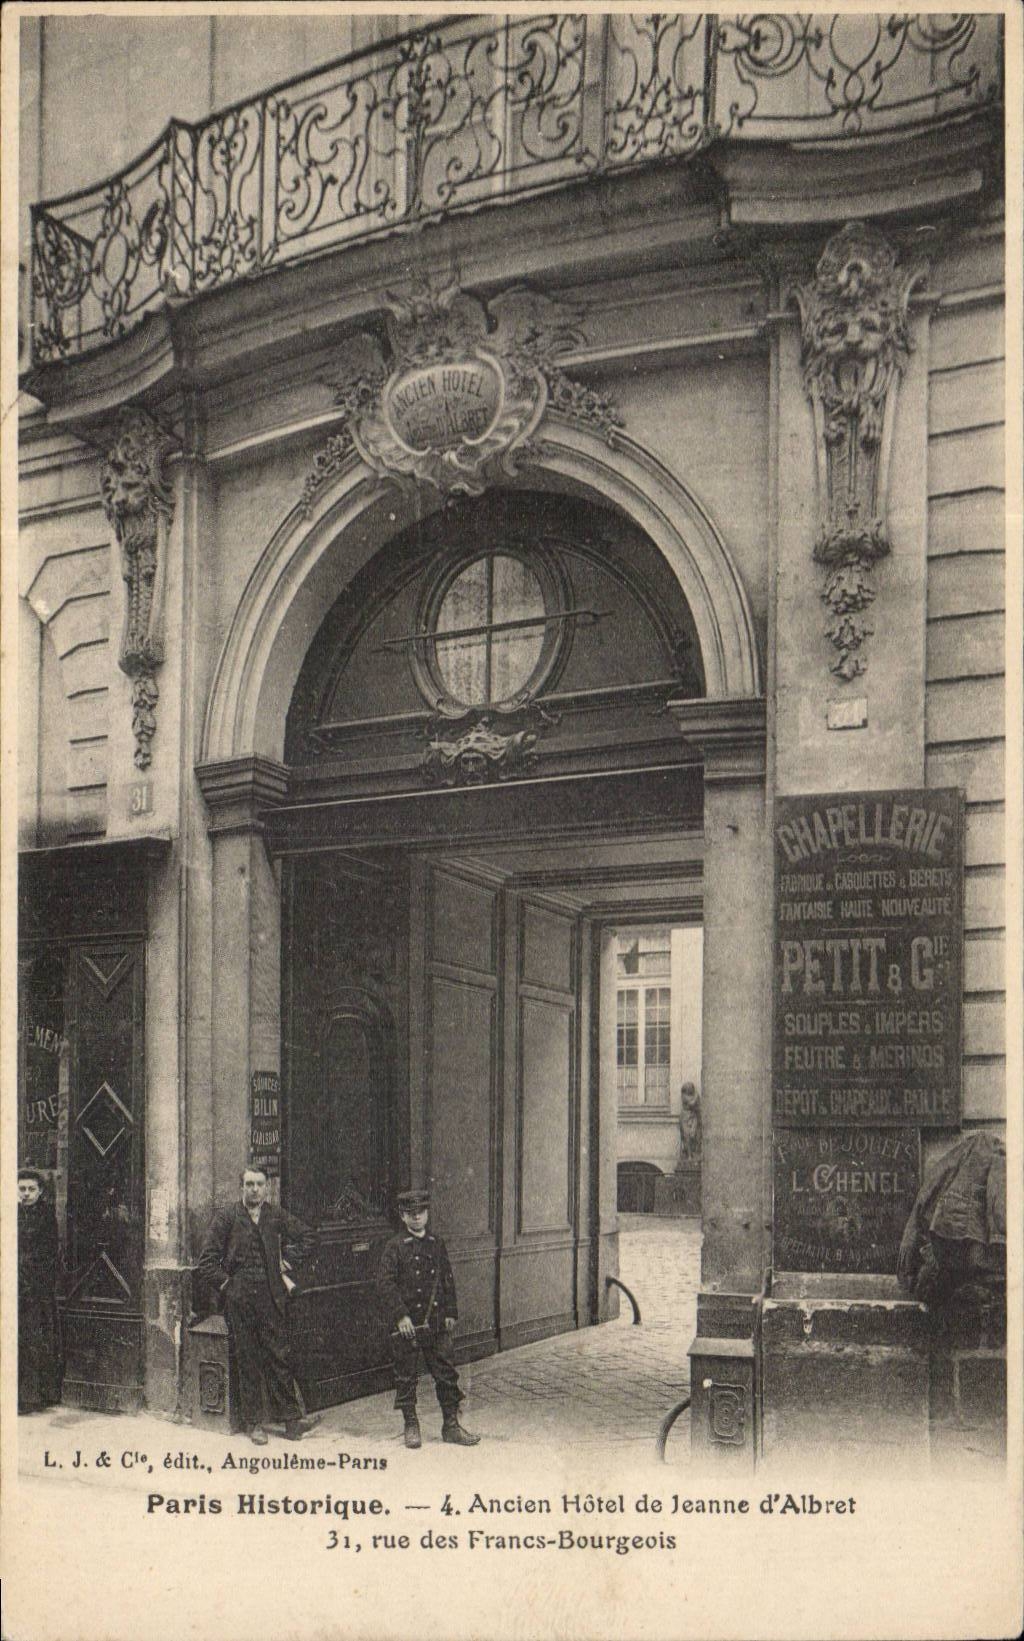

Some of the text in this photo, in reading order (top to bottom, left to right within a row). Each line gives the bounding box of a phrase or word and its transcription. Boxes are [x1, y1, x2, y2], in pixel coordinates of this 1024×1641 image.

[391, 374, 437, 420] ANCIEN
[132, 786, 148, 811] 31
[778, 803, 952, 863] CHAPELLERIE
[780, 873, 825, 893] FABRIQUE
[835, 870, 897, 891] CASQUETTES
[780, 900, 833, 920] FANTAISIE
[841, 898, 874, 919] HAUTE
[780, 937, 887, 994] PETIT
[887, 964, 902, 994] &
[784, 1012, 860, 1036] SOUPLES
[875, 1010, 944, 1036] IMPERS
[785, 1046, 846, 1070] FEUTRE
[253, 1098, 278, 1117] BILIN
[792, 1171, 810, 1192] L.
